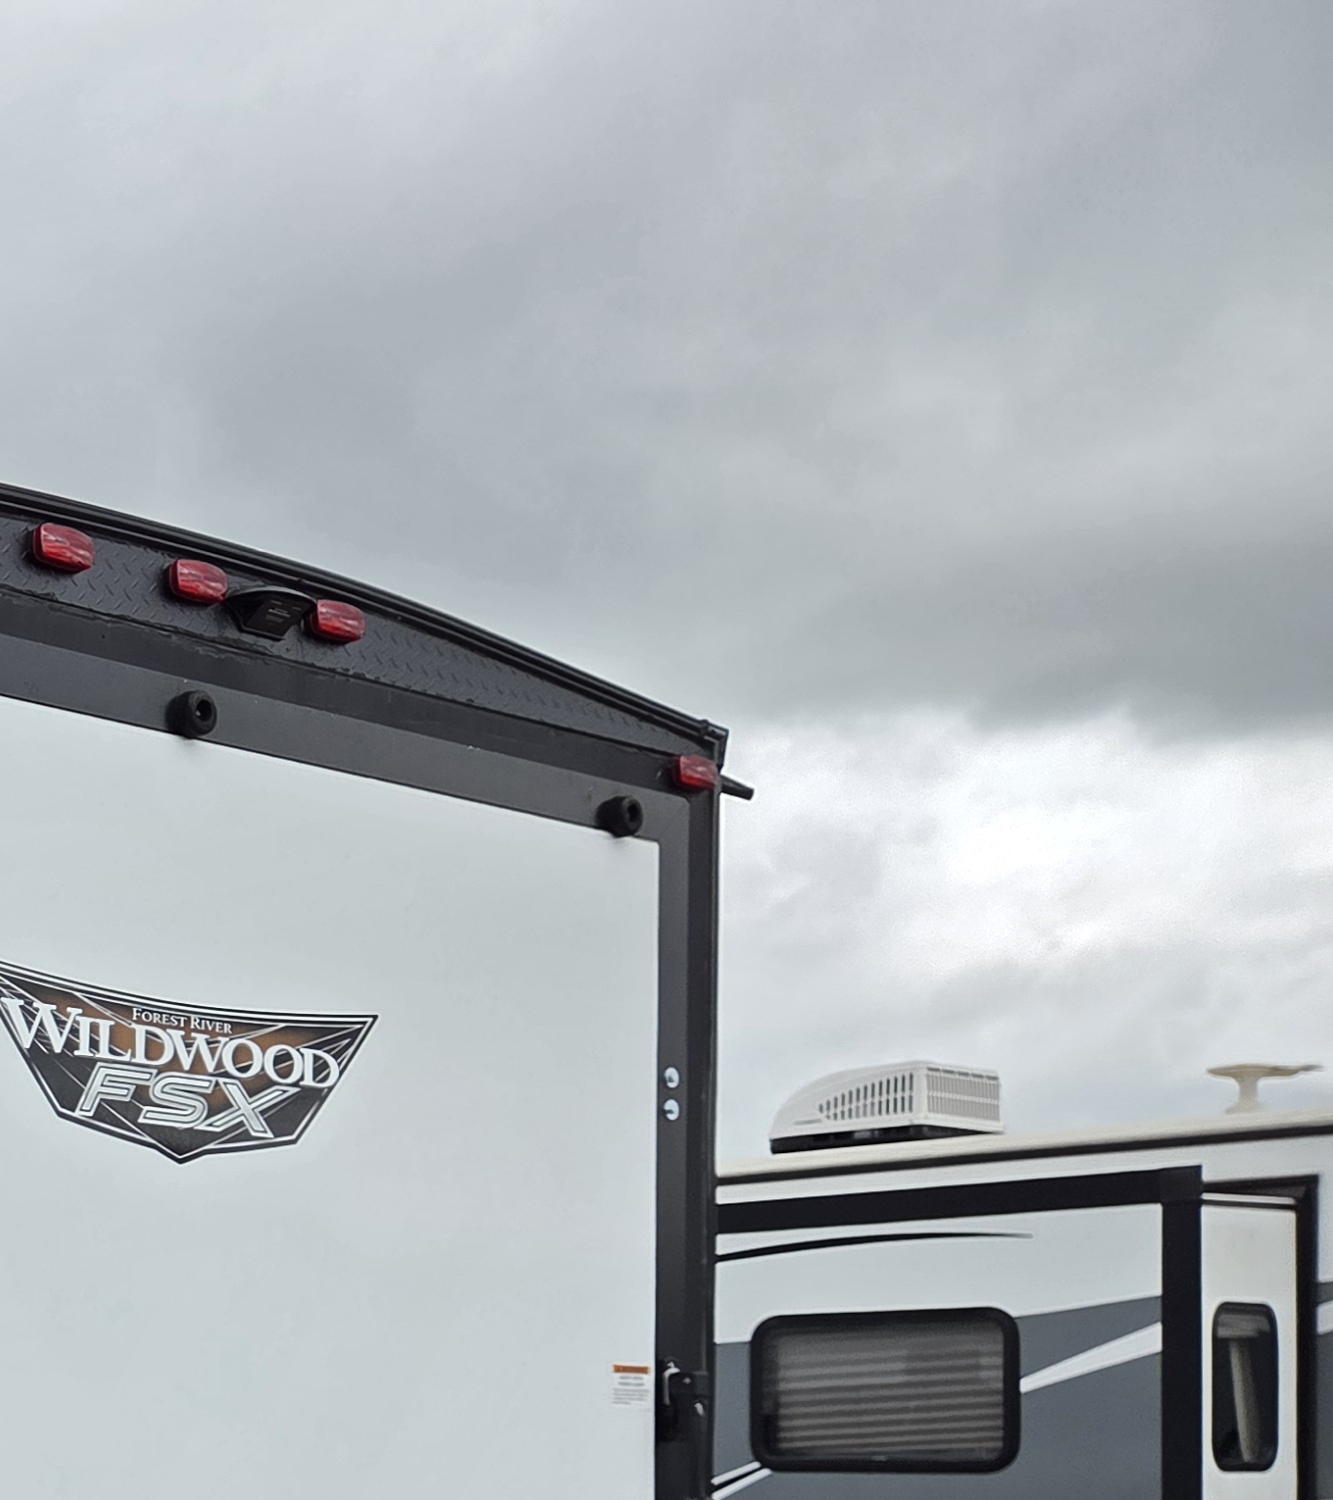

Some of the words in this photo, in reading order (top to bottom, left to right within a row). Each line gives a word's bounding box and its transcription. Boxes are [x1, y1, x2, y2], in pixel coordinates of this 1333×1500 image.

[0, 996, 341, 1088] WILDWOOD
[131, 1006, 188, 1028] FOREST
[189, 1016, 233, 1036] RIVER
[73, 1061, 301, 1138] FSX
